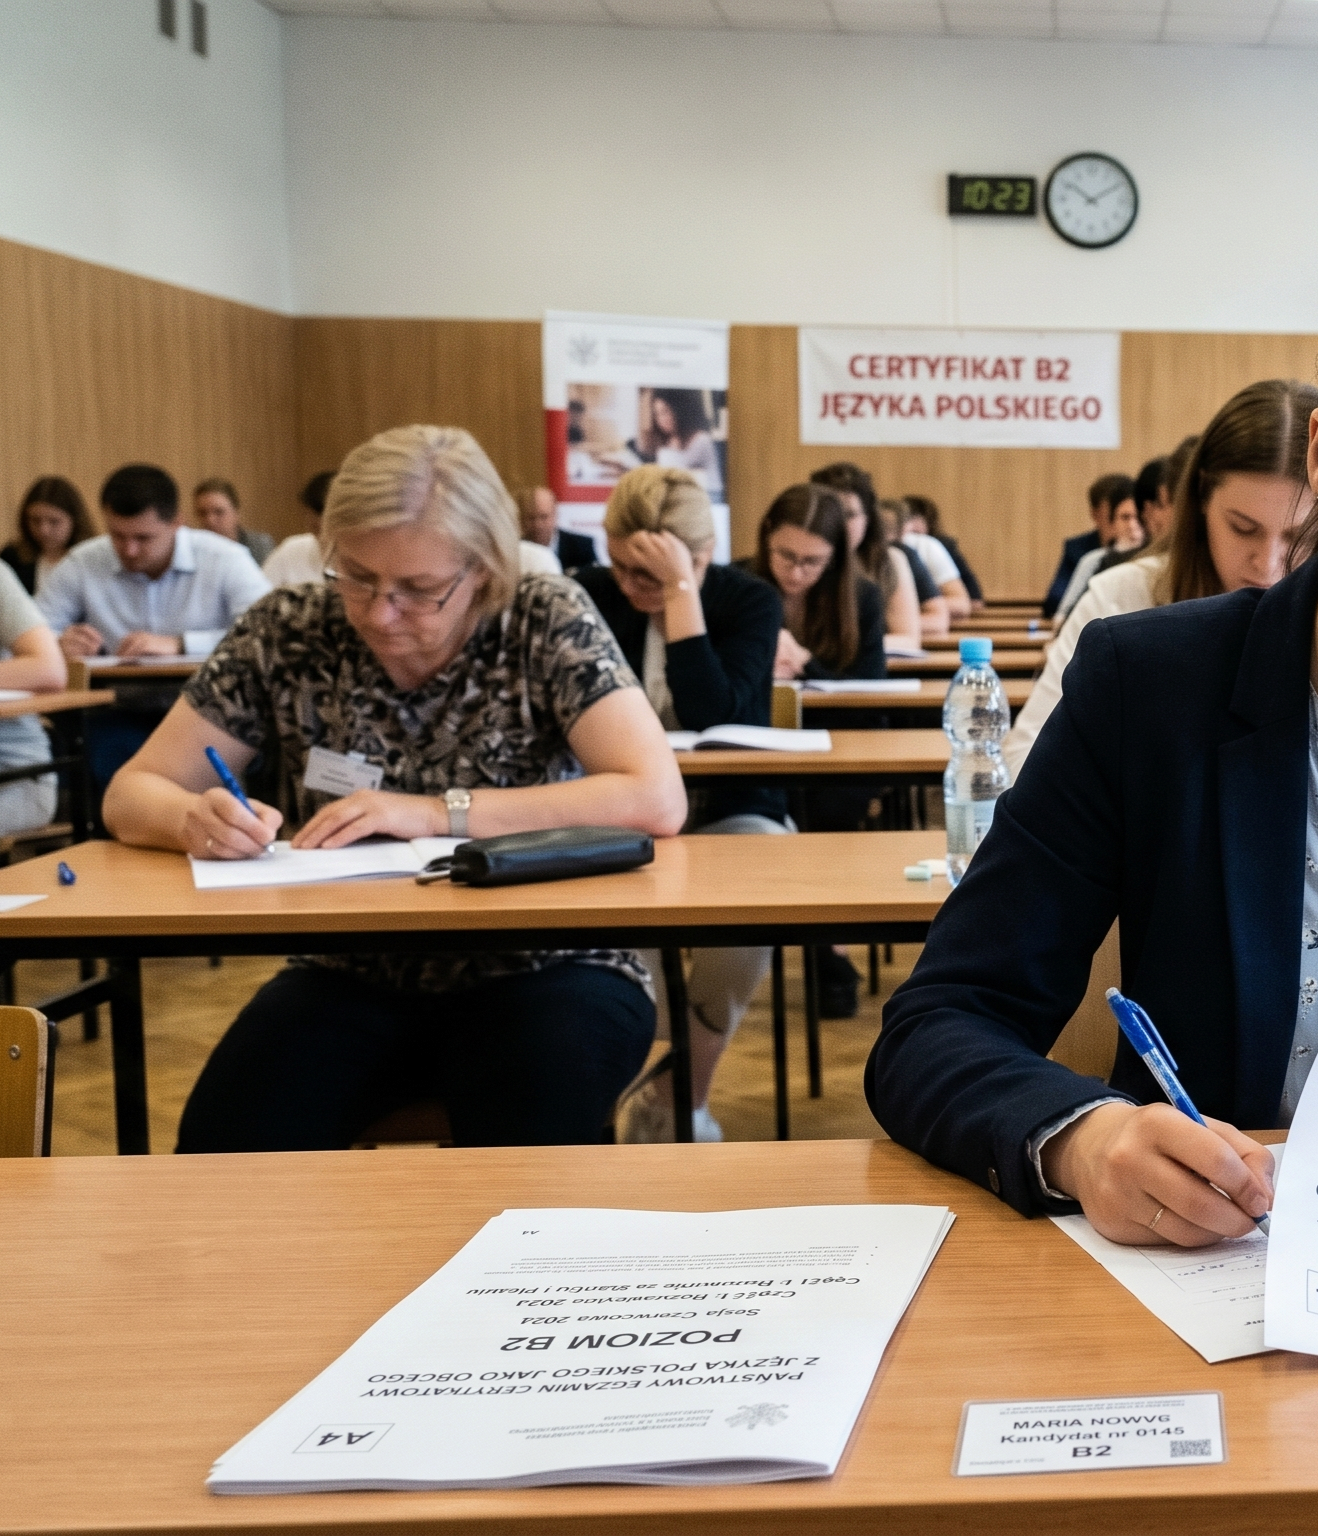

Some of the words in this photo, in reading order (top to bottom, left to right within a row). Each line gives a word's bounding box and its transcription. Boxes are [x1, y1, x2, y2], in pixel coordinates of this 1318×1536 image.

[848, 354, 1025, 380] CERTYFIKAT
[1034, 356, 1072, 382] B2
[820, 392, 927, 425] JĘZYKA
[935, 395, 1103, 421] POLSKIEGO
[499, 1336, 556, 1352] B2
[566, 1328, 743, 1350] POZIOM
[705, 1356, 799, 1370] JĘZYKA
[803, 1357, 821, 1366] Z
[368, 1372, 473, 1383] OBCEGO
[479, 1370, 548, 1380] JAKO
[552, 1362, 698, 1378] POLSKIEGO
[537, 1380, 642, 1393] EGZAMIN
[645, 1372, 804, 1388] PAŃSTWOWY
[1013, 1418, 1083, 1430] MARIA
[316, 1431, 377, 1446] A4
[1000, 1430, 1101, 1444] Kandydat
[1108, 1430, 1130, 1439] nr
[1136, 1427, 1185, 1438] 0145
[1071, 1445, 1112, 1458] B2
